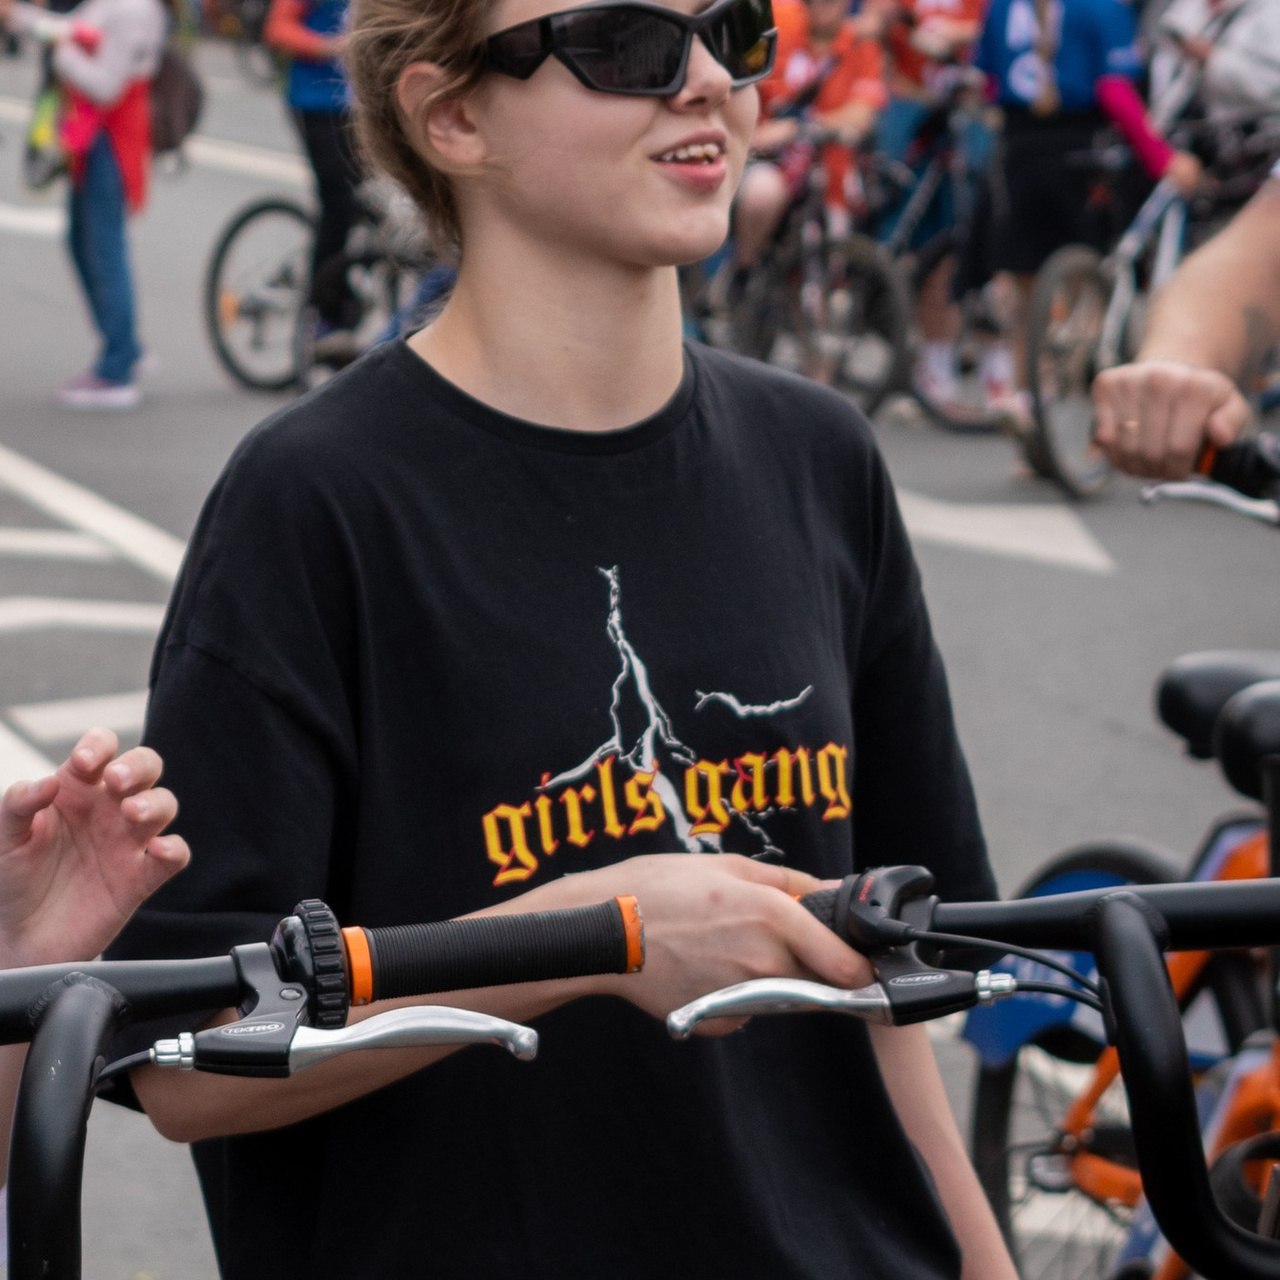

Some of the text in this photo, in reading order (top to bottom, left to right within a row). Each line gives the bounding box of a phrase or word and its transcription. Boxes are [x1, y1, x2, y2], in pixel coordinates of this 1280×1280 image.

[481, 740, 852, 887] girls gang
[227, 1023, 280, 1034] TEKTRO
